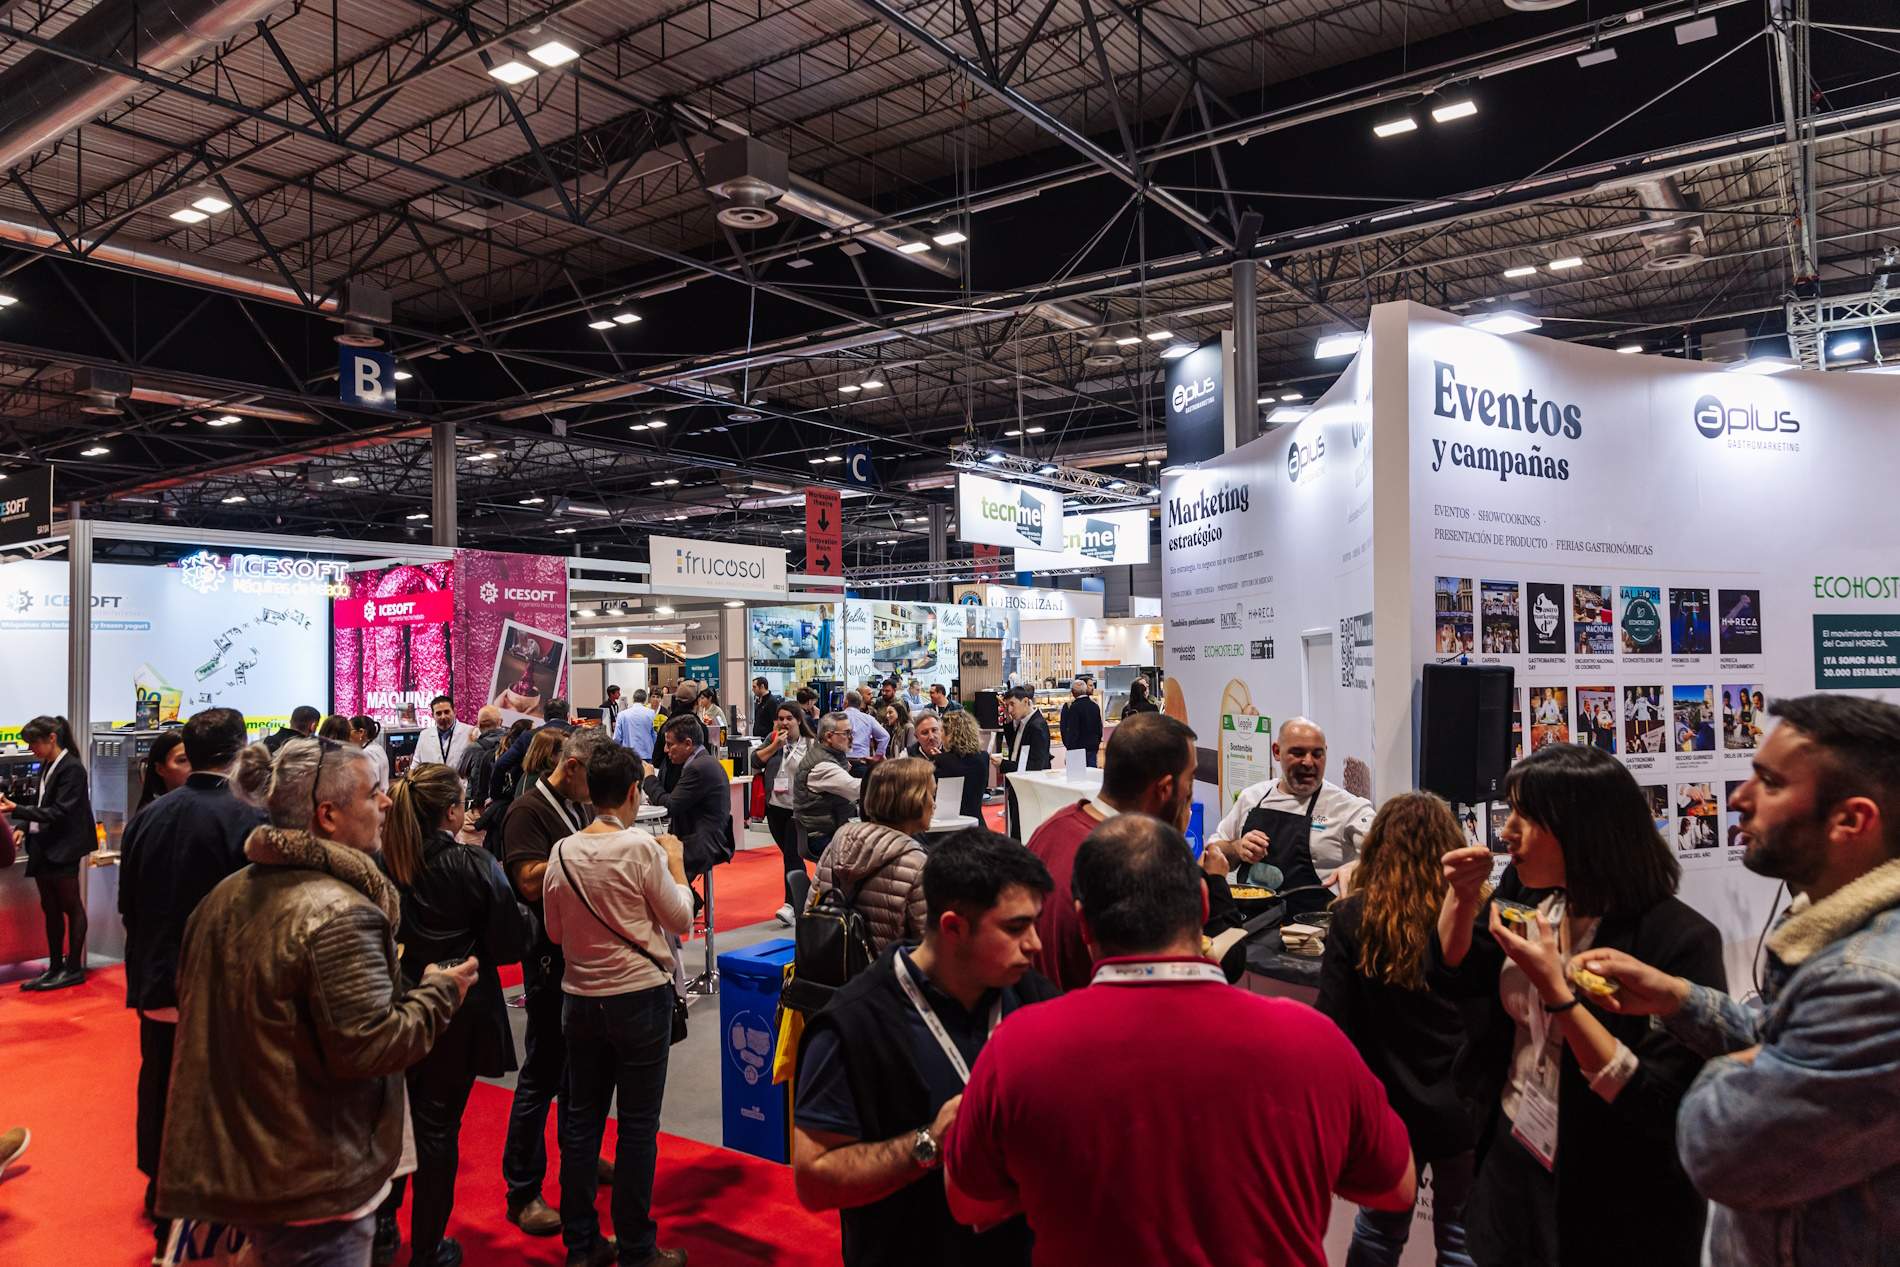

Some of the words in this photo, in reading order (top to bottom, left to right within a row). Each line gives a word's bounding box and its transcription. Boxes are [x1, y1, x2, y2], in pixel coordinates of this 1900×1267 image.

[354, 355, 384, 401] B
[1432, 360, 1583, 440] Eventos
[1727, 439, 1800, 453] GASTROMARKETING
[852, 453, 867, 482] C
[1432, 438, 1447, 473] y
[1450, 441, 1570, 482] campañas
[1168, 480, 1250, 528] Marketing
[1434, 504, 1470, 520] EVENTOS
[1478, 509, 1541, 527] SHOWCOOKINGS
[1168, 523, 1223, 552] estratégico
[1434, 527, 1493, 545] PRESENTACIÓN
[1493, 533, 1505, 546] DE
[1505, 535, 1549, 550] PRODUCTO
[1556, 539, 1585, 553] FERIAS
[1585, 541, 1654, 556] GASTRONÓMICAS
[230, 553, 350, 583] ICESOFT
[685, 550, 765, 580] frucosol
[504, 587, 558, 602] ICESOFT
[1813, 575, 1899, 599] ECOHOST
[44, 594, 122, 608] ICEOFT
[378, 601, 417, 617] ICESOFT
[1004, 595, 1064, 611] HOSHIZAKI
[1822, 629, 1830, 638] El
[1830, 629, 1872, 638] movimiento
[1872, 629, 1882, 638] de
[1823, 639, 1834, 648] del
[1834, 639, 1855, 648] Canal
[1855, 639, 1889, 648] HORECA.
[846, 645, 871, 657] ri-jado
[1837, 655, 1866, 665] SOMOS
[1867, 653, 1885, 665] MÁS
[1885, 655, 1897, 665] DE
[1823, 668, 1852, 677] 30.000
